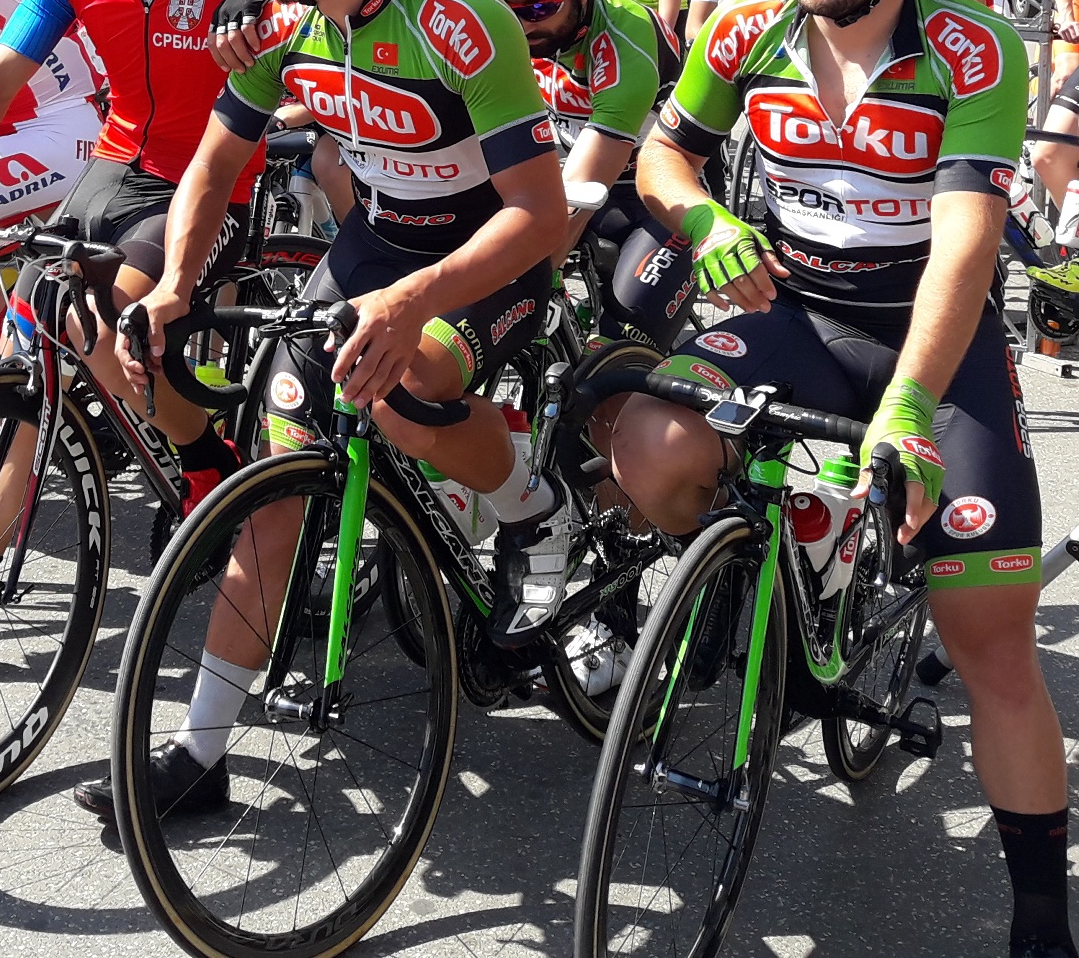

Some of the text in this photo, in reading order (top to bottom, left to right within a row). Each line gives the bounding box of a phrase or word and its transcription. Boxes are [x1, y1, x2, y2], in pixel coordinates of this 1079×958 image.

[152, 32, 210, 51] СРБИЈА
[429, 0, 479, 66] Torku
[712, 9, 777, 68] Torku
[936, 17, 986, 90] Torku
[294, 77, 418, 135] Torku
[759, 102, 929, 160] Torku
[845, 198, 931, 217] TOT
[640, 248, 678, 287] SPOR
[932, 563, 960, 574] Torku
[995, 557, 1030, 570] Torku
